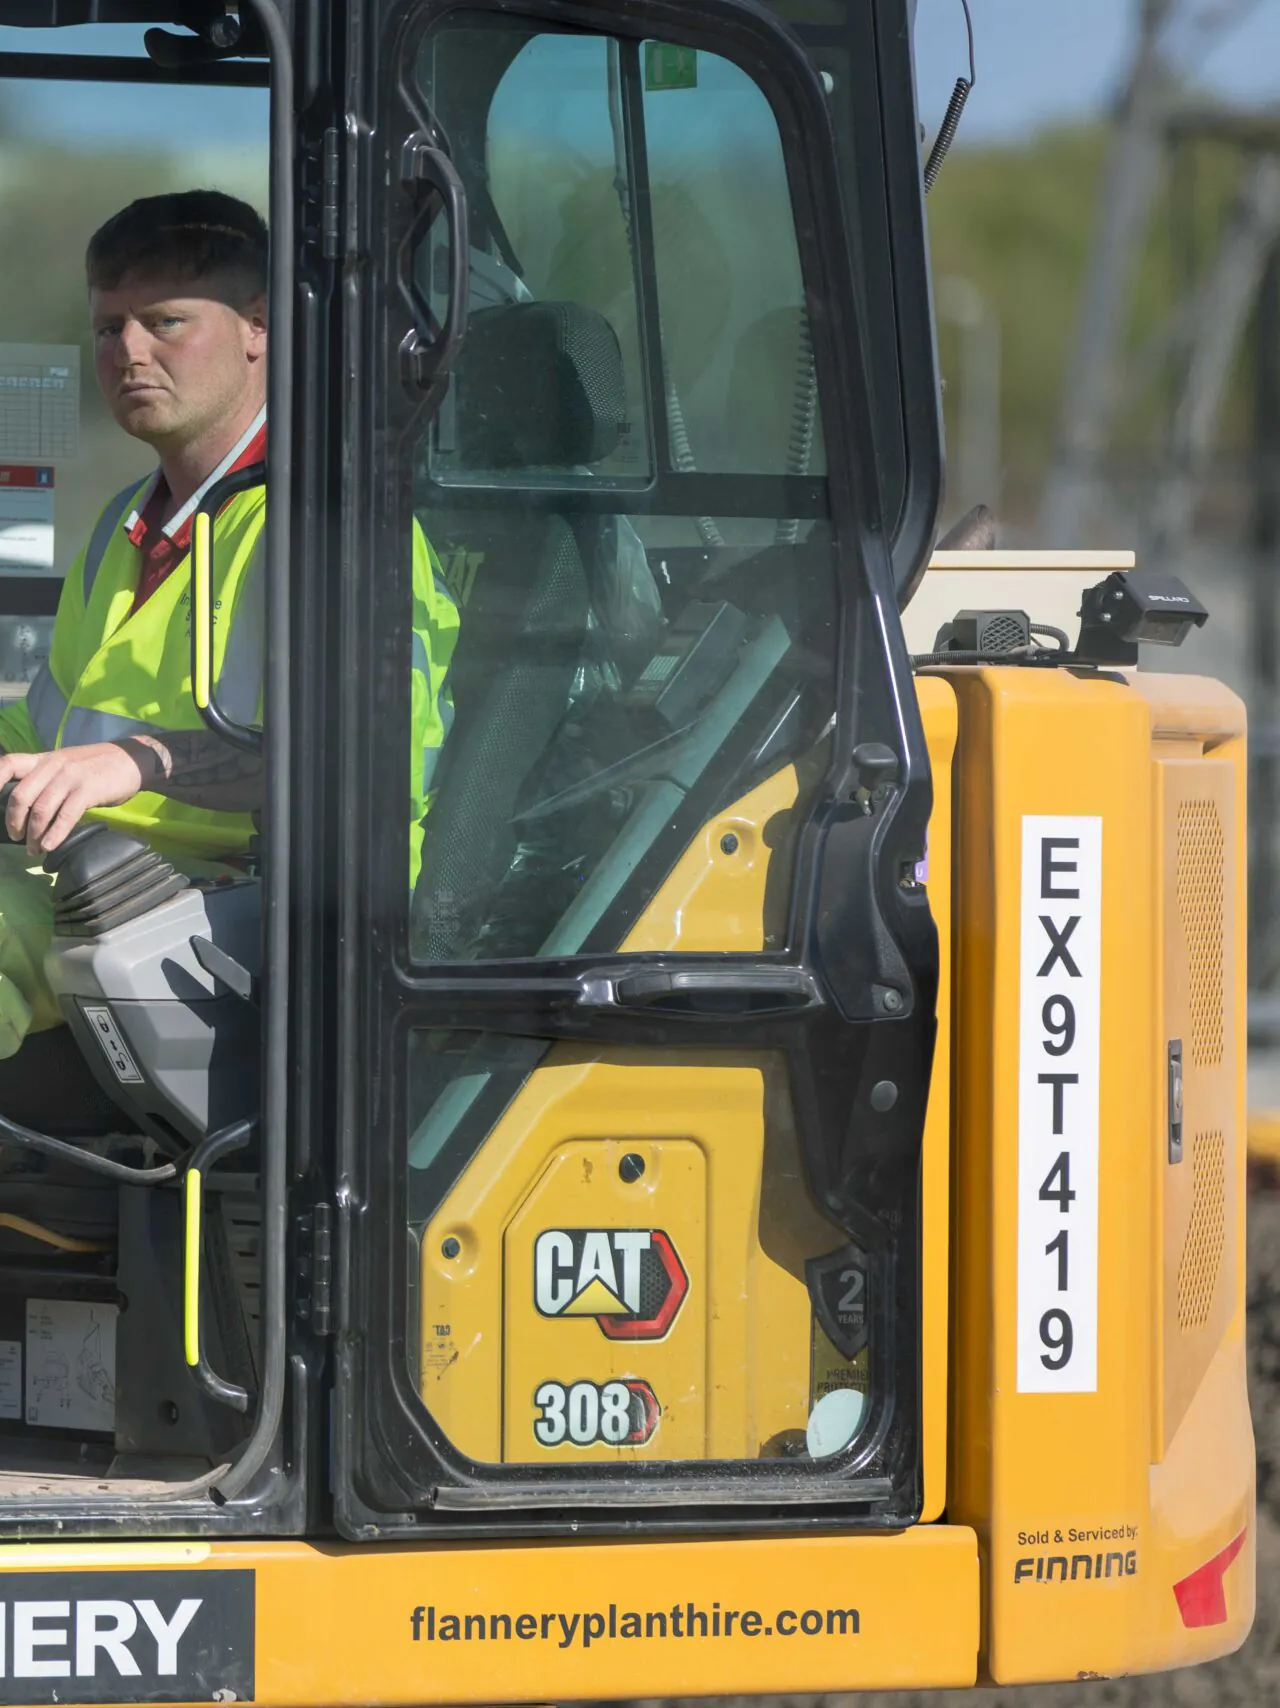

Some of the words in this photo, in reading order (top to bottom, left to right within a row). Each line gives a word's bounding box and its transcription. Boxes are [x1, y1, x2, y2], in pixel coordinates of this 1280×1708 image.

[1035, 837, 1083, 1371] EX9T419
[535, 1230, 651, 1315] CAT
[838, 1269, 864, 1312] 2
[837, 1314, 864, 1324] YEARS
[536, 1382, 630, 1443] 308
[1017, 1531, 1049, 1545] Sold
[1053, 1529, 1064, 1543] &
[1068, 1525, 1125, 1542] Serviced
[1014, 1550, 1137, 1584] FINNING
[410, 1603, 861, 1648] flanneryplanthire.com
